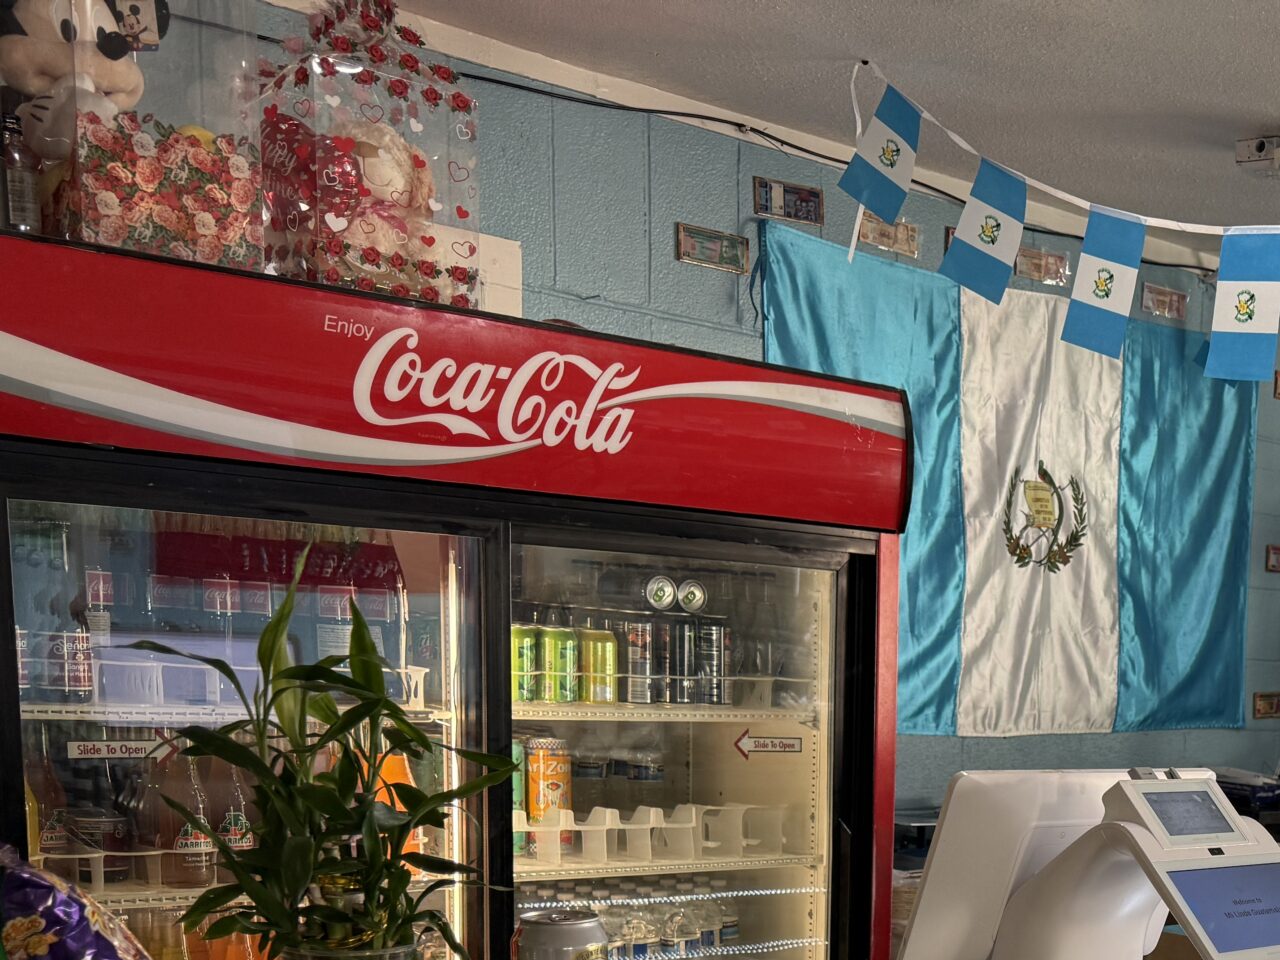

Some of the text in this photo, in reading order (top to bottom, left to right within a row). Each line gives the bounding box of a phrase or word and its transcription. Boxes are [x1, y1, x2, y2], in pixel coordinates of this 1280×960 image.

[323, 315, 375, 340] Enjoy
[352, 327, 642, 455] Coca-Cola
[76, 743, 147, 757] Slide To Open
[178, 840, 213, 849] JARRITOS
